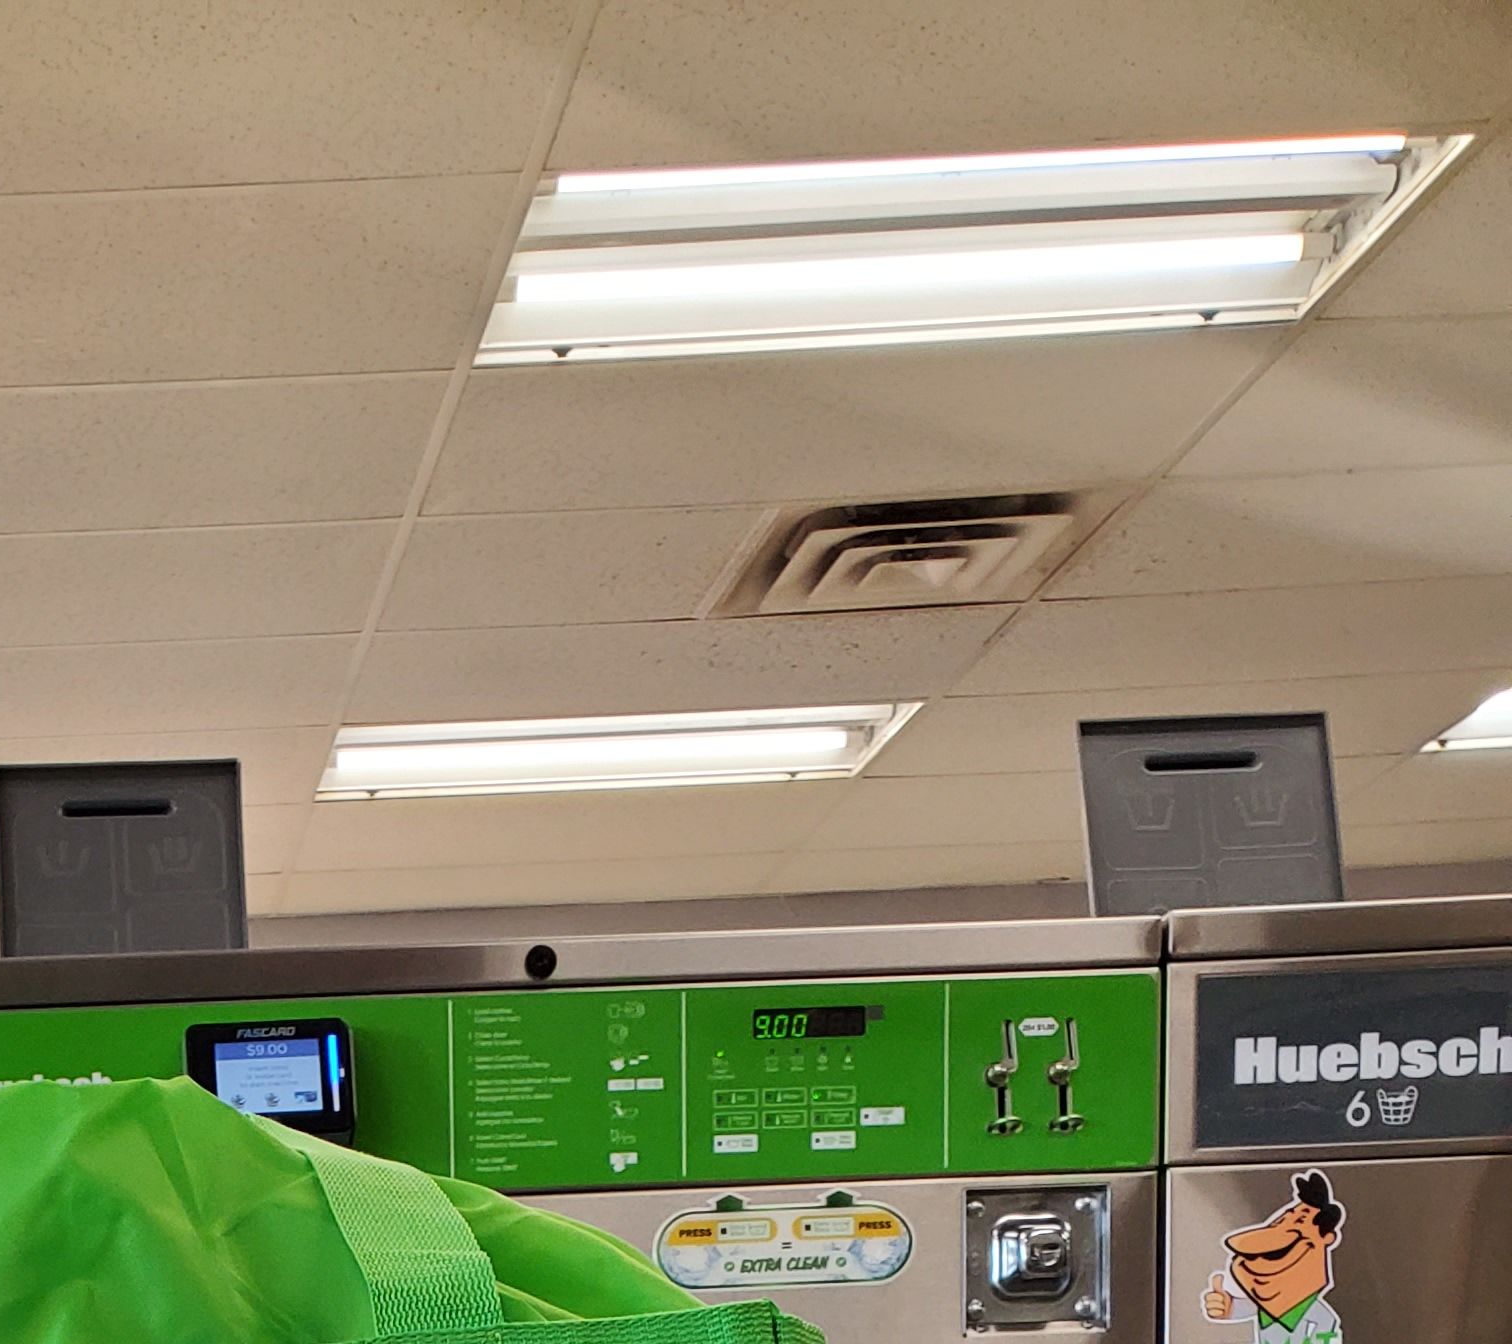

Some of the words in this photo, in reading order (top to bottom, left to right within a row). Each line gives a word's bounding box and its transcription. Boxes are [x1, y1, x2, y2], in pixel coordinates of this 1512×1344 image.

[235, 1025, 296, 1039] FASCARD
[755, 1013, 808, 1039] 9.00
[1233, 1026, 1512, 1085] Huebsch
[1345, 1089, 1371, 1127] 6
[678, 1228, 712, 1238] PRESS
[858, 1220, 892, 1230] PRESS
[739, 1257, 781, 1273] EXTRA
[786, 1255, 830, 1270] CLEAN
